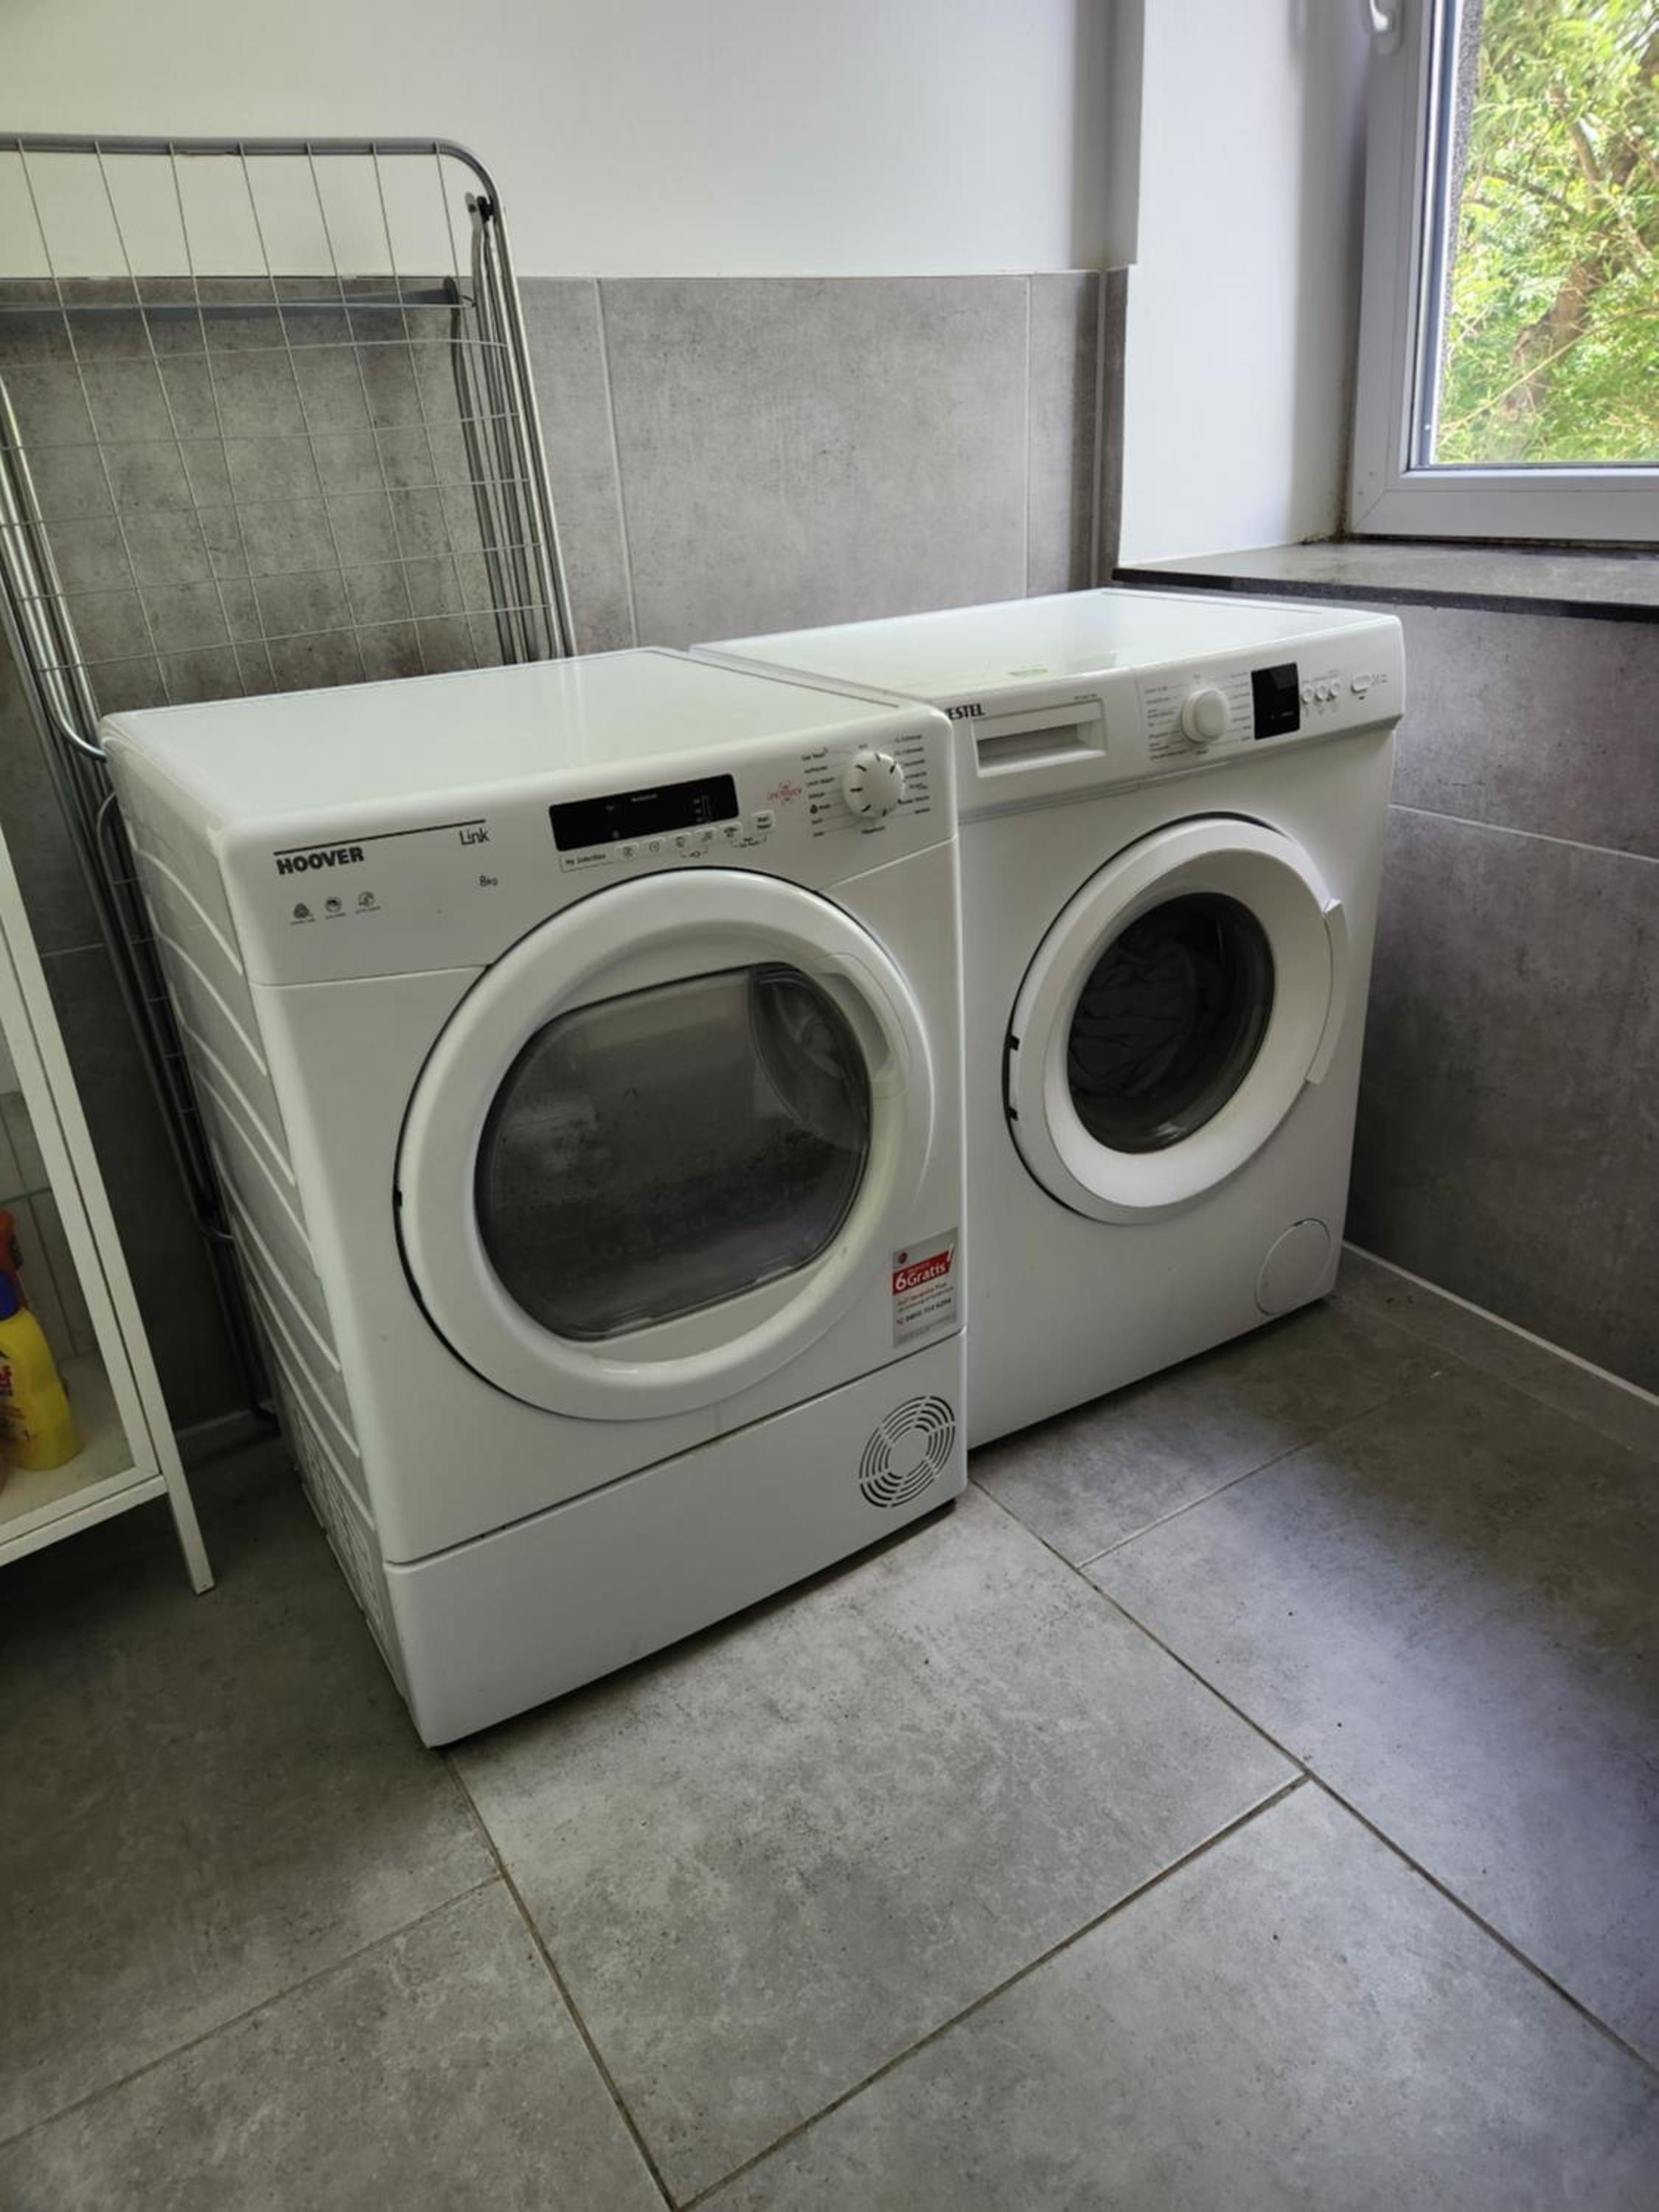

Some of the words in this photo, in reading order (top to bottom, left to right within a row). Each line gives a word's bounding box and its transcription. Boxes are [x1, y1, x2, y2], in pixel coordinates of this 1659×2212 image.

[459, 827, 490, 846] Link
[276, 846, 364, 875] HOOVER
[895, 1271, 907, 1290] 6
[907, 1262, 947, 1287] Gratis
